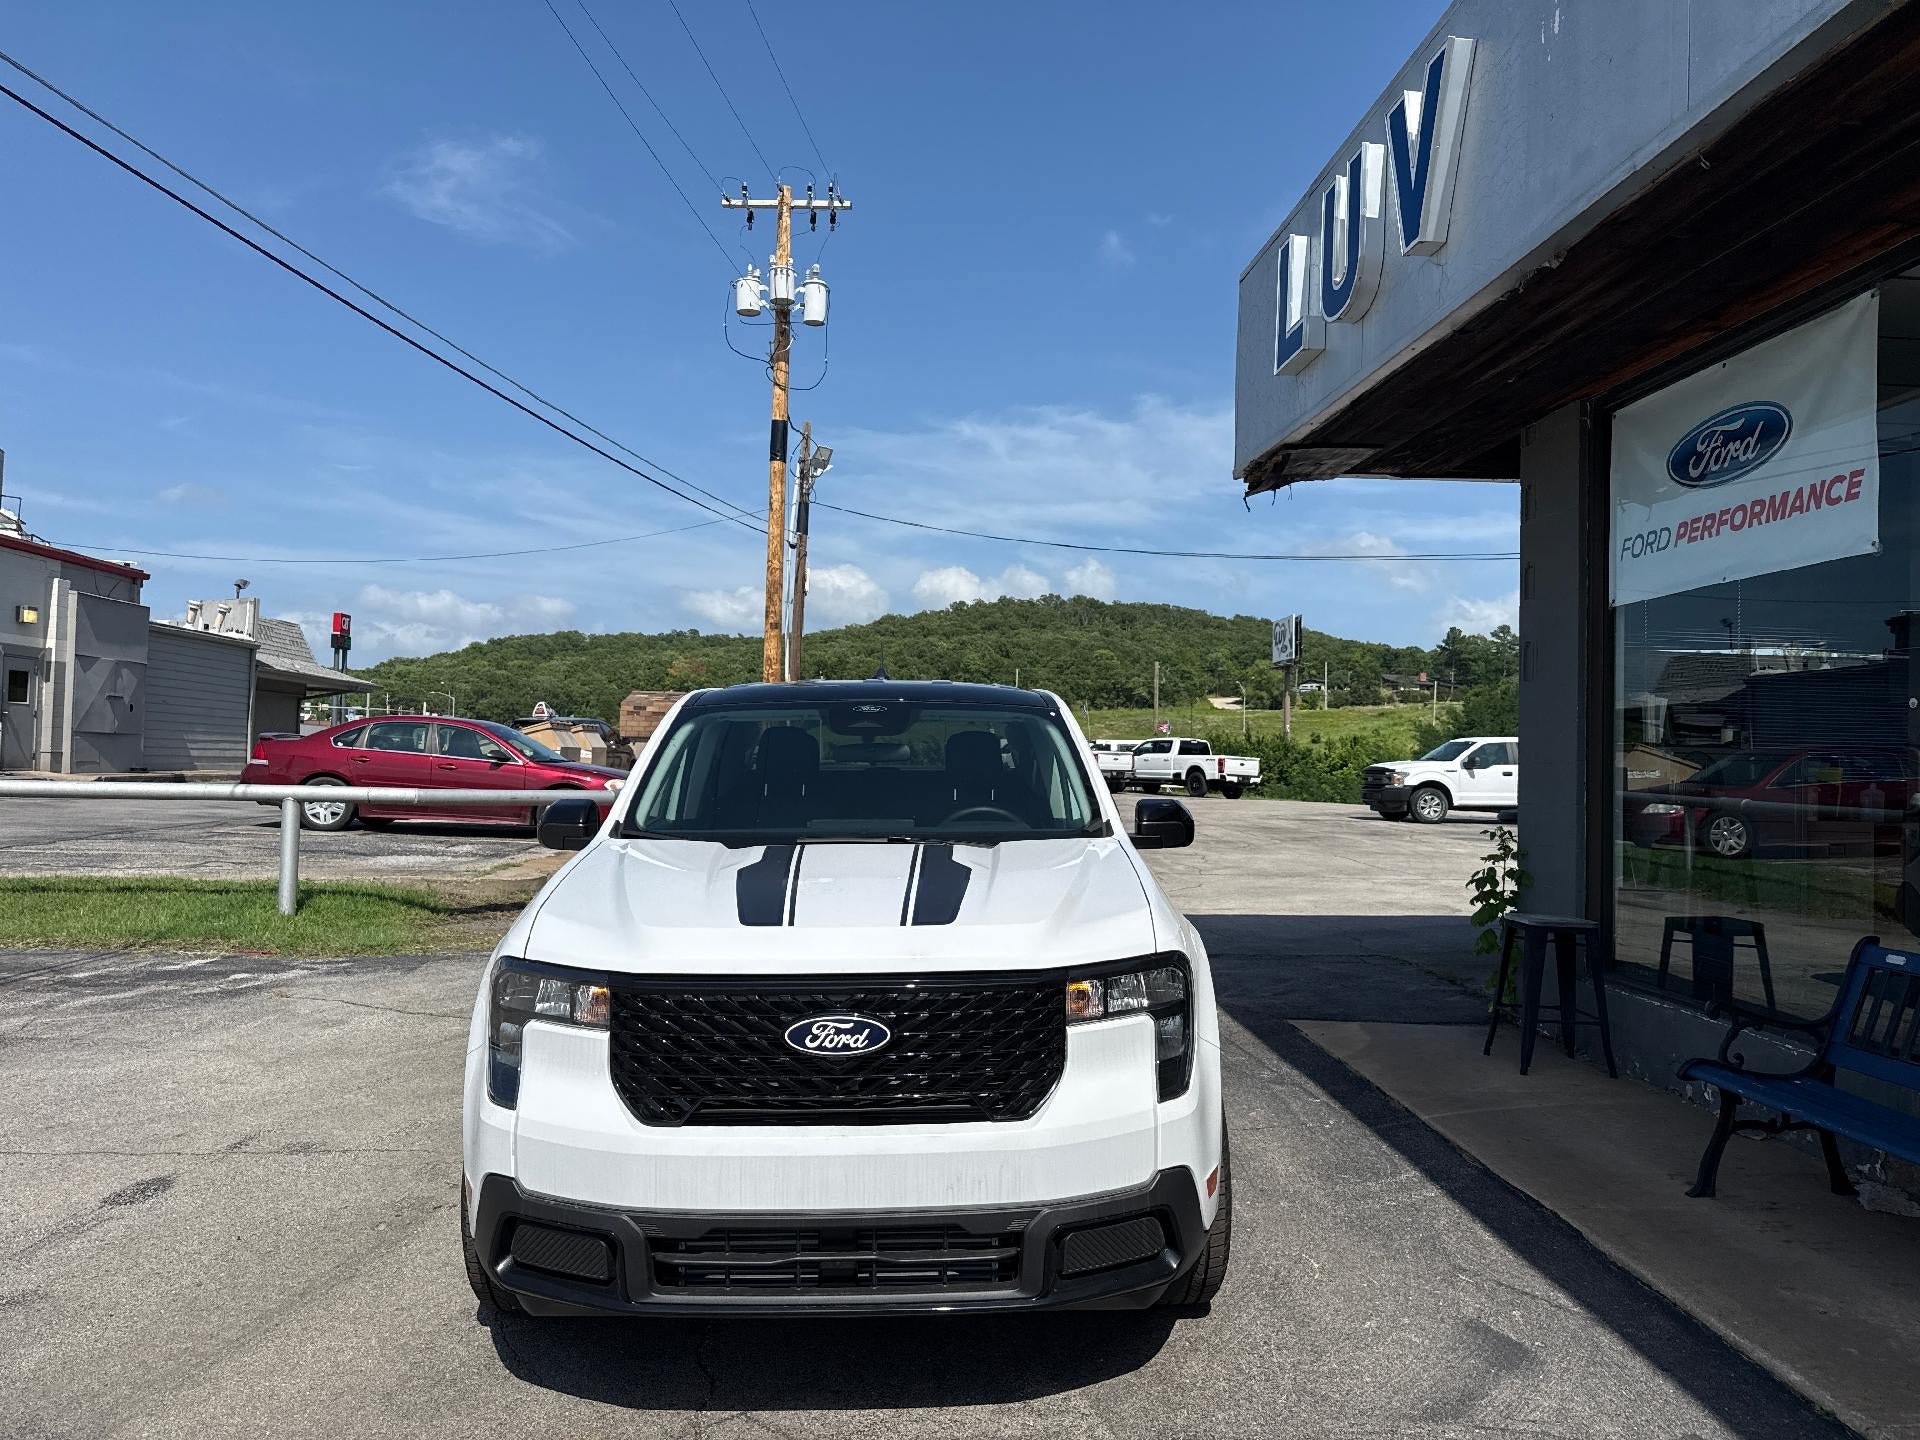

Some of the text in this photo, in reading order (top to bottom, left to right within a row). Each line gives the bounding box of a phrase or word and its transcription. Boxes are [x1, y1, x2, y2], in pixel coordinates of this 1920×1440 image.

[1274, 36, 1477, 376] LUV
[1689, 418, 1764, 478] Ford
[1620, 468, 1866, 561] FORD PERFORMANCE
[805, 1021, 871, 1048] Ford
